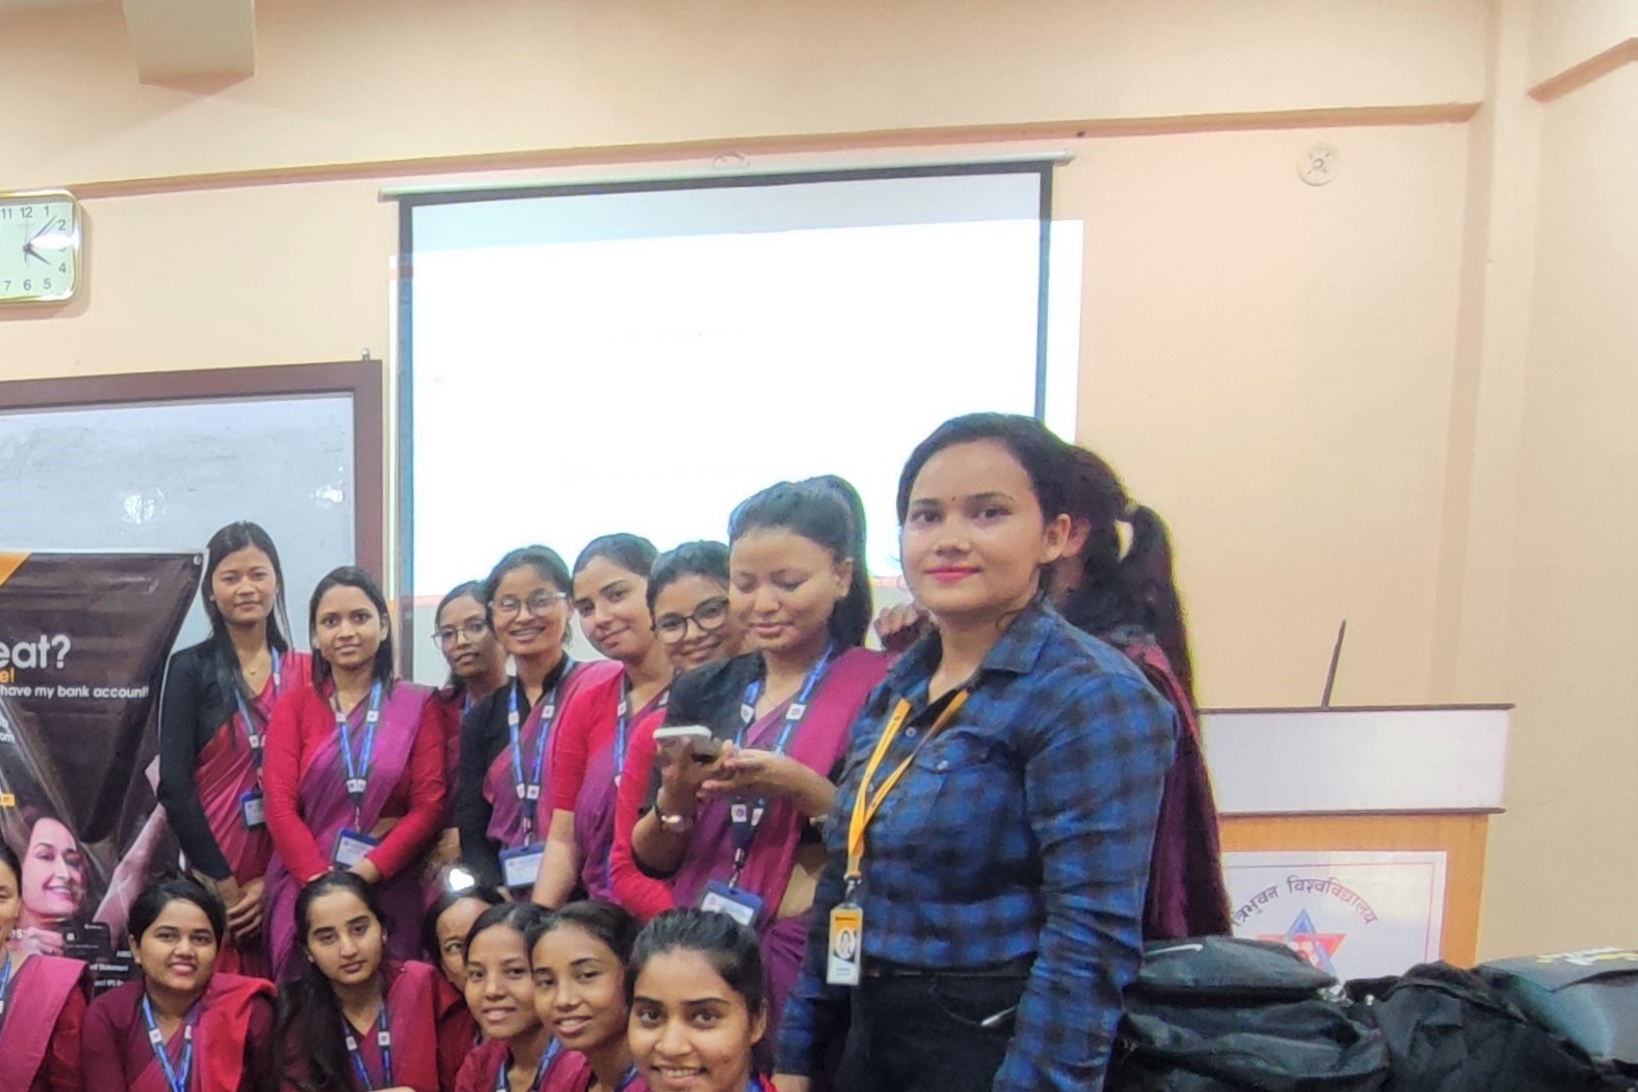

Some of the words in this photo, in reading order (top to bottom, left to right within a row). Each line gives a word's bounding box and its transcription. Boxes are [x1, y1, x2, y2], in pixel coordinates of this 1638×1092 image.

[0, 207, 13, 220] 11
[19, 206, 33, 219] 12
[44, 205, 50, 217] 1
[57, 218, 66, 232] 2
[58, 262, 66, 274] 4
[3, 280, 12, 292] 7
[23, 278, 32, 291] 6
[43, 278, 52, 290] 5
[0, 685, 32, 697] have
[35, 687, 54, 699] my
[58, 685, 89, 698] bank
